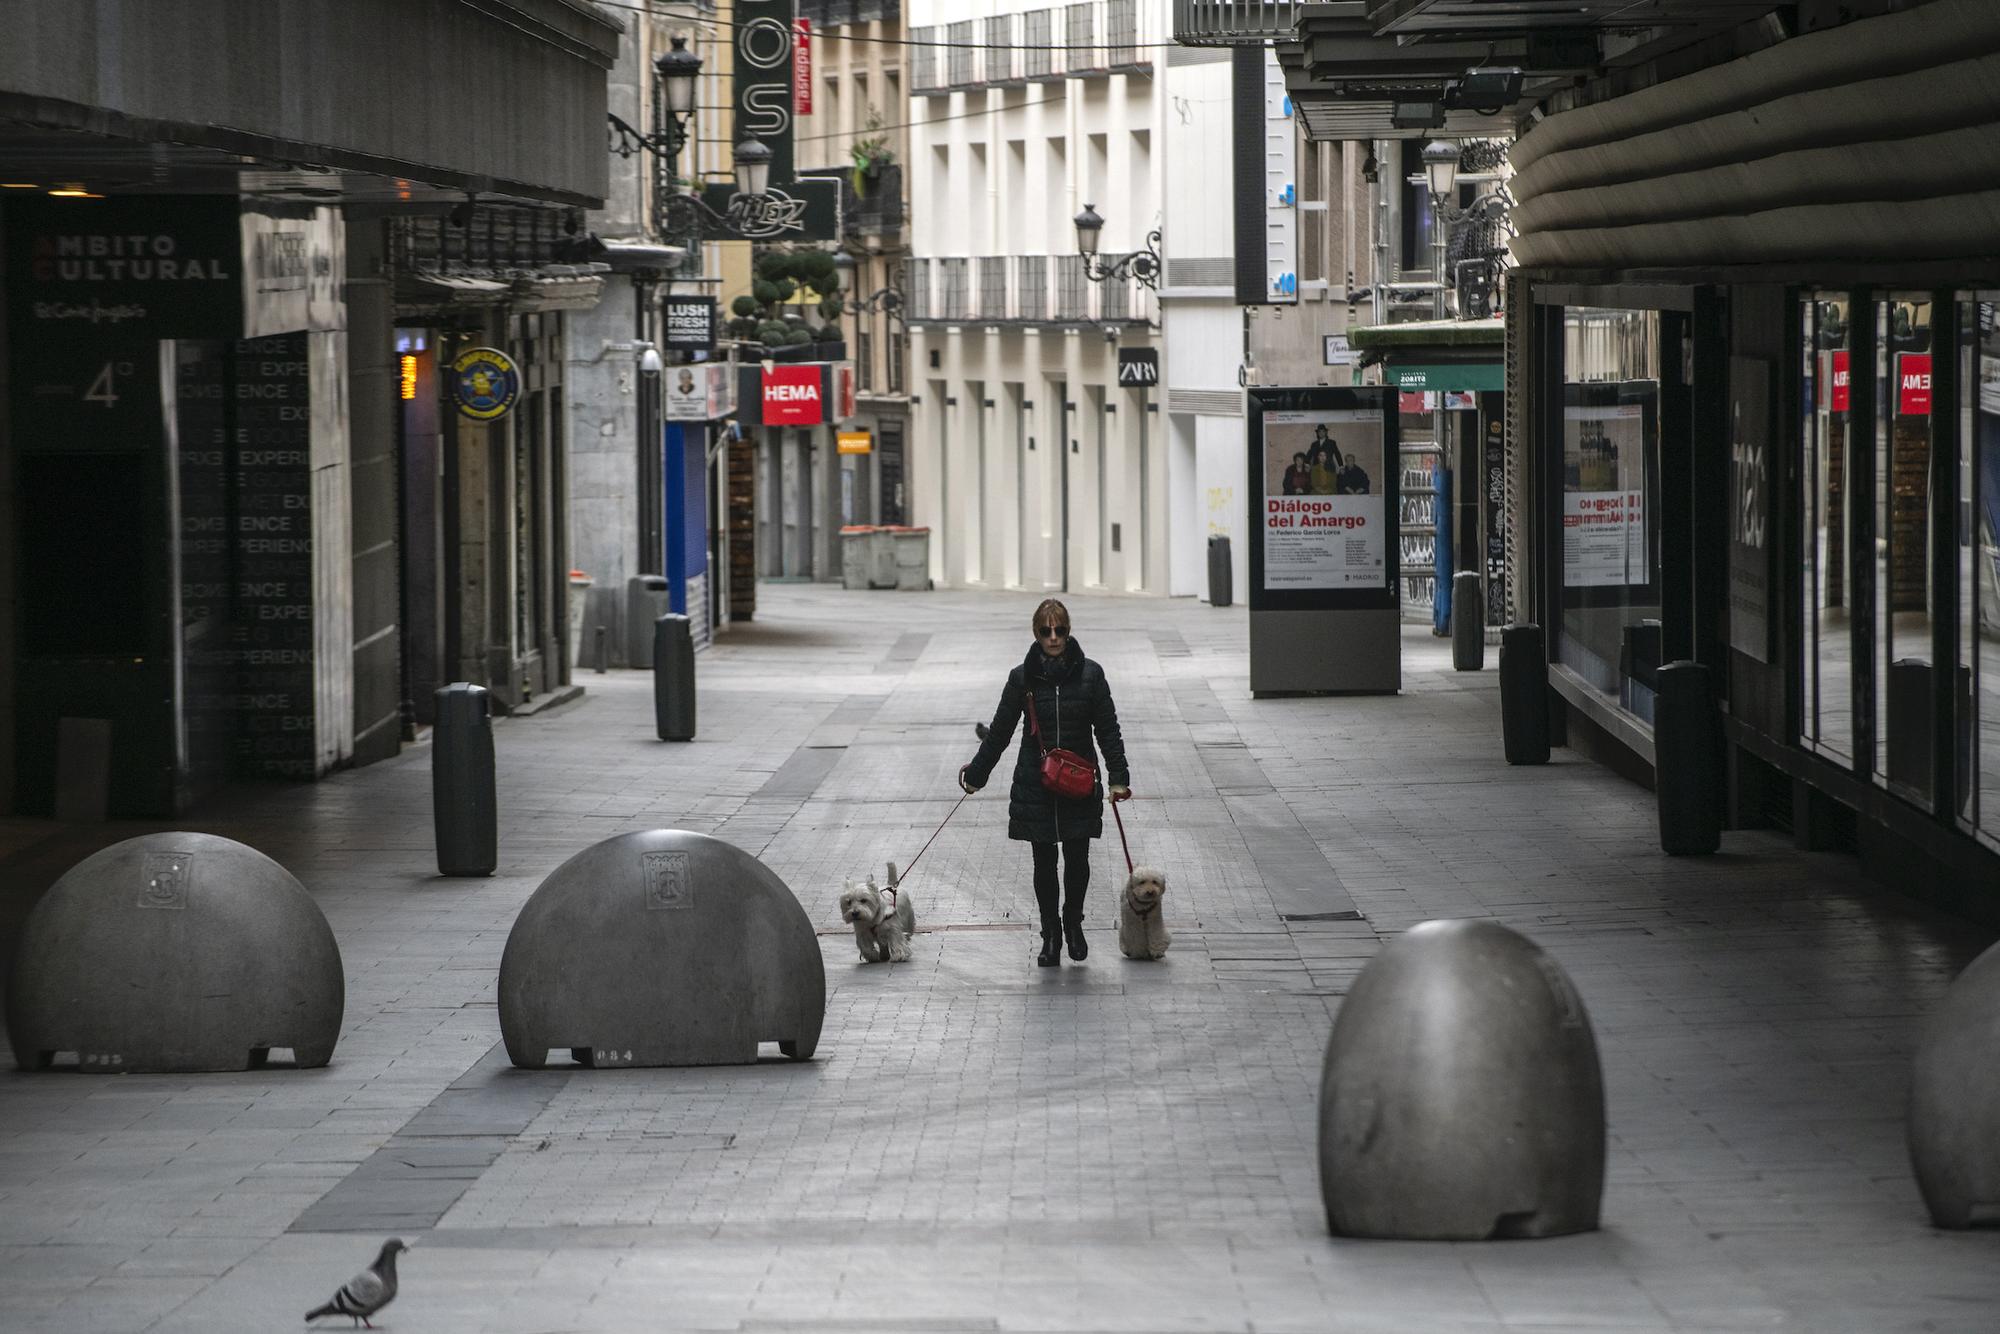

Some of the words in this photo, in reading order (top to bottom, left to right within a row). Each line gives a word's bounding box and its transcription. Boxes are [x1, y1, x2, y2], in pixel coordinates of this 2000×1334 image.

[34, 235, 174, 256] MBITO
[667, 304, 710, 317] LUSH
[667, 317, 710, 328] FRESH
[764, 385, 819, 401] HEMA
[1268, 500, 1332, 514] Diálogo
[1268, 515, 1294, 527] del
[1300, 515, 1366, 528] Amargo
